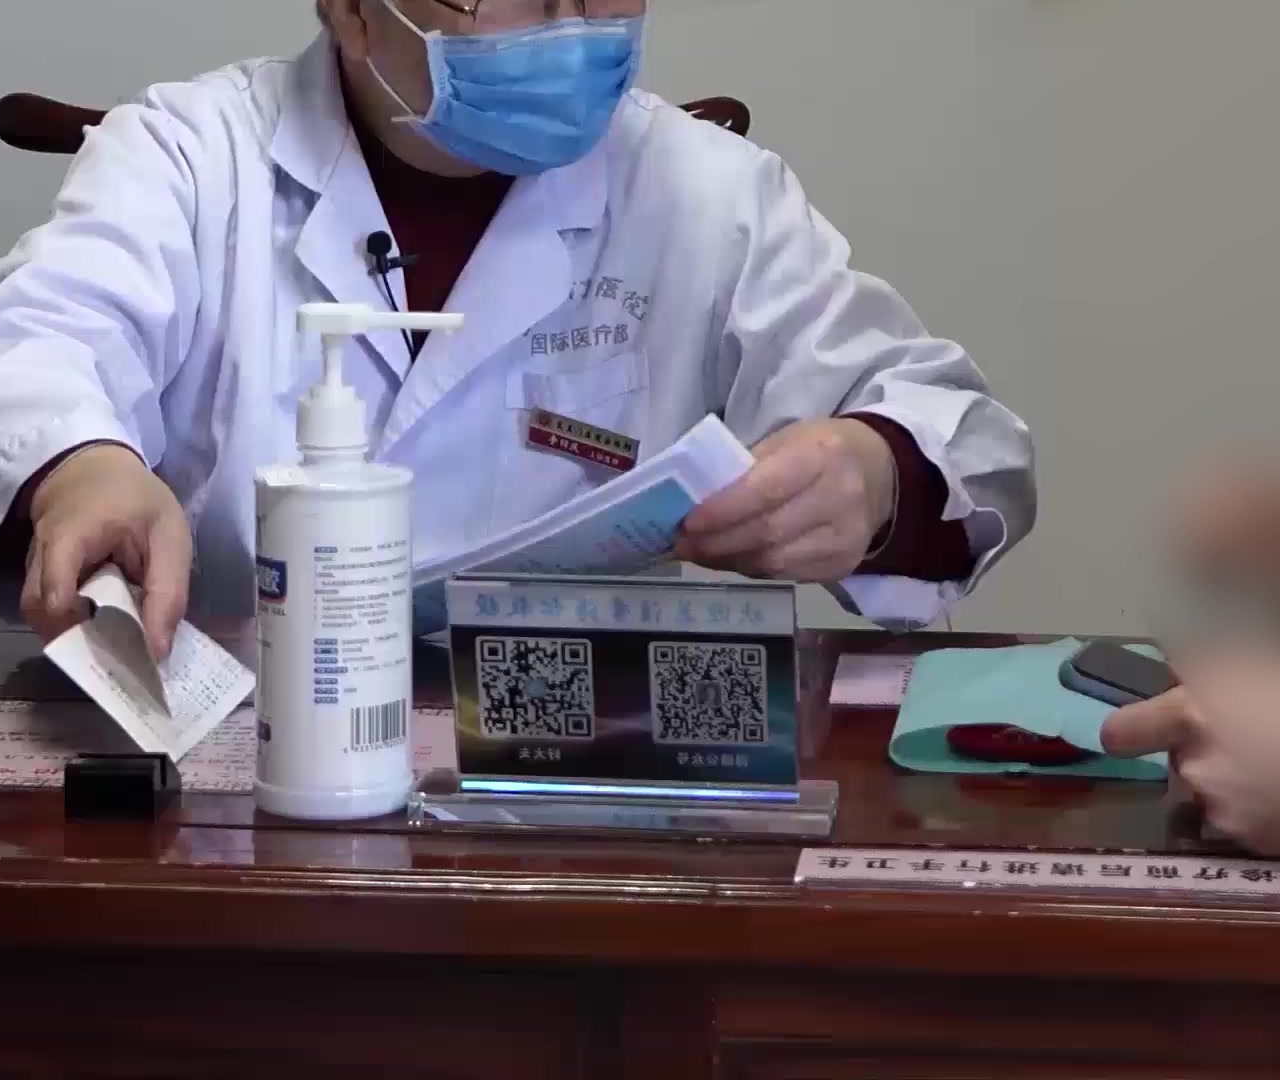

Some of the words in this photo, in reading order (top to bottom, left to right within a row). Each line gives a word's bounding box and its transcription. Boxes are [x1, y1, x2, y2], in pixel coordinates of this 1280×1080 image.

[530, 323, 630, 357] 国际医疗部
[816, 856, 1280, 882] 诊疗前后请进行手卫生
